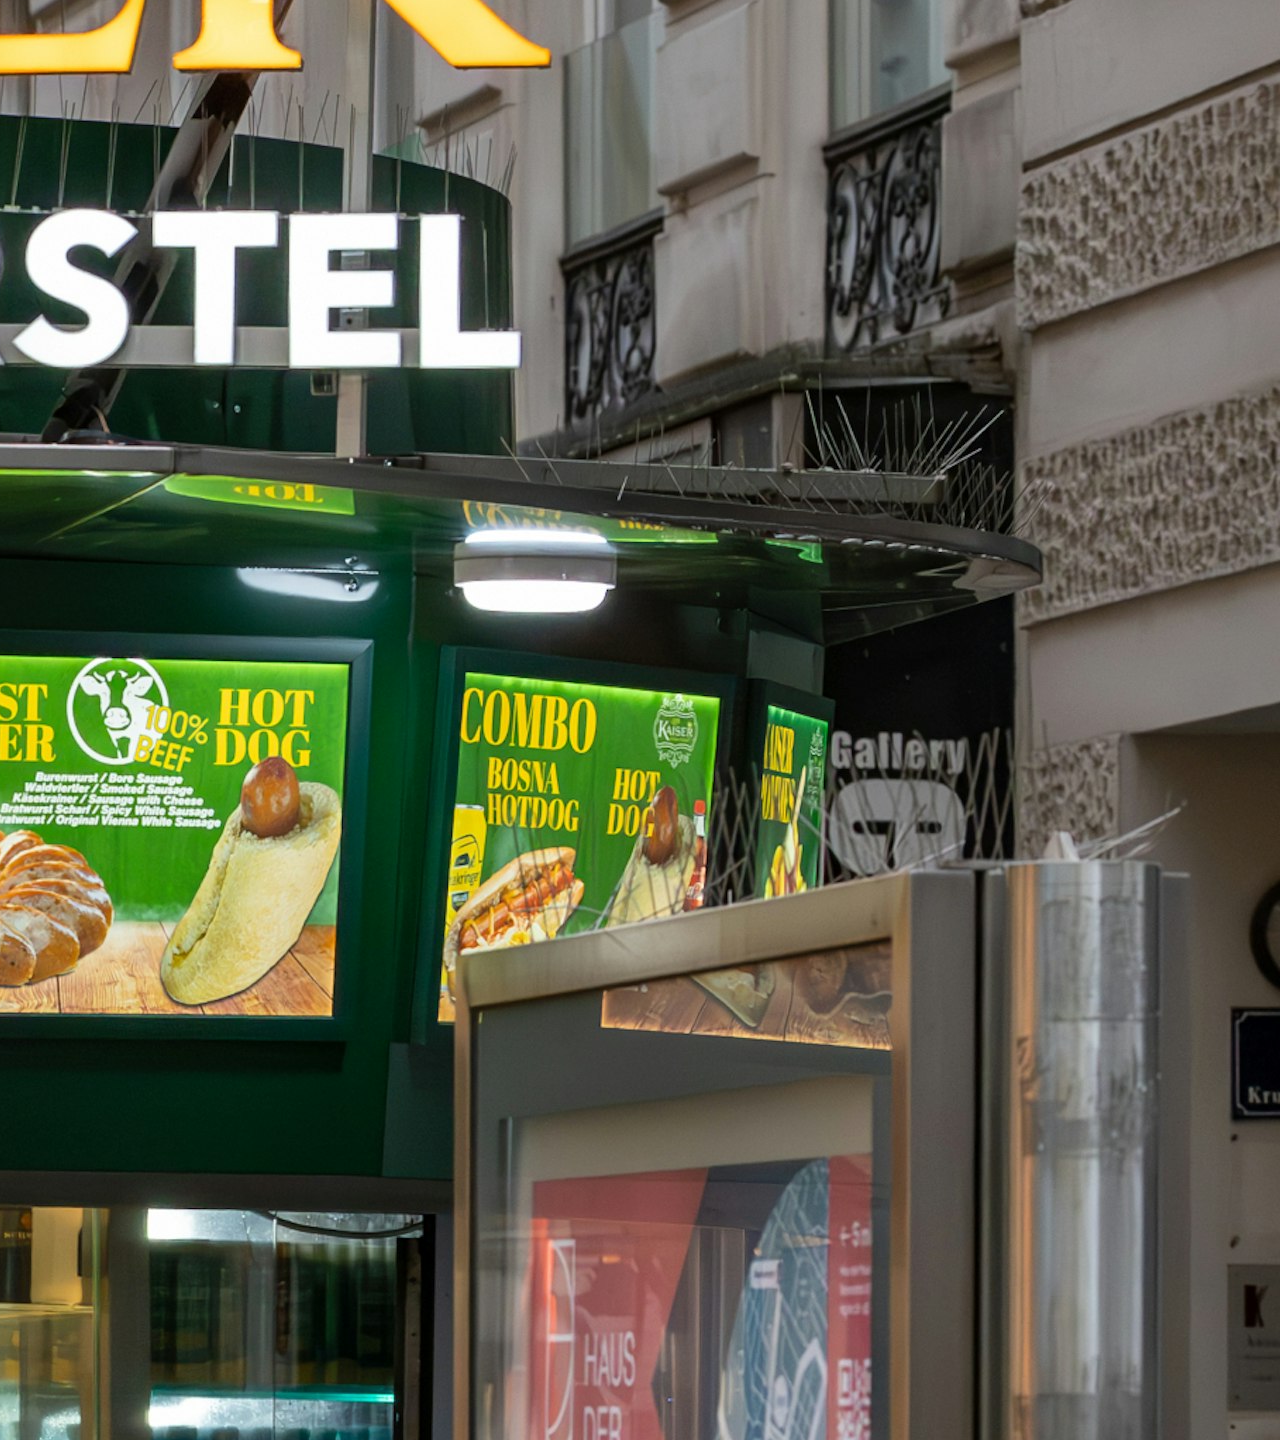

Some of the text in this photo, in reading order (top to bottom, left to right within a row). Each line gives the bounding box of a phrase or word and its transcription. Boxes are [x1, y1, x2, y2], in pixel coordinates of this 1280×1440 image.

[145, 704, 209, 746] 100%
[218, 687, 315, 727] HOT
[460, 687, 598, 754] COMBO
[214, 727, 312, 768] DOG
[658, 719, 694, 742] KAISER
[133, 735, 195, 774] BEEF
[831, 730, 968, 776] Gallery
[35, 771, 98, 783] Burenwurst
[136, 773, 183, 785] Sausage
[100, 783, 144, 794] Smoked
[147, 784, 193, 796] Sausage
[487, 756, 560, 795] BOSNA
[613, 767, 661, 802] HOT
[0, 802, 53, 814] Bratwurst
[100, 805, 132, 817] Spicy
[135, 806, 166, 817] White
[168, 806, 215, 818] Sausage
[88, 794, 133, 806] Sausage
[137, 794, 161, 805] with
[163, 795, 204, 806] Cheese
[486, 792, 580, 833] HOTDOG
[55, 814, 99, 827] Original
[101, 815, 139, 826] Vienna
[141, 816, 172, 827] White
[174, 817, 222, 830] Sausage
[606, 803, 656, 839] DOG
[583, 1330, 636, 1389] HAUS
